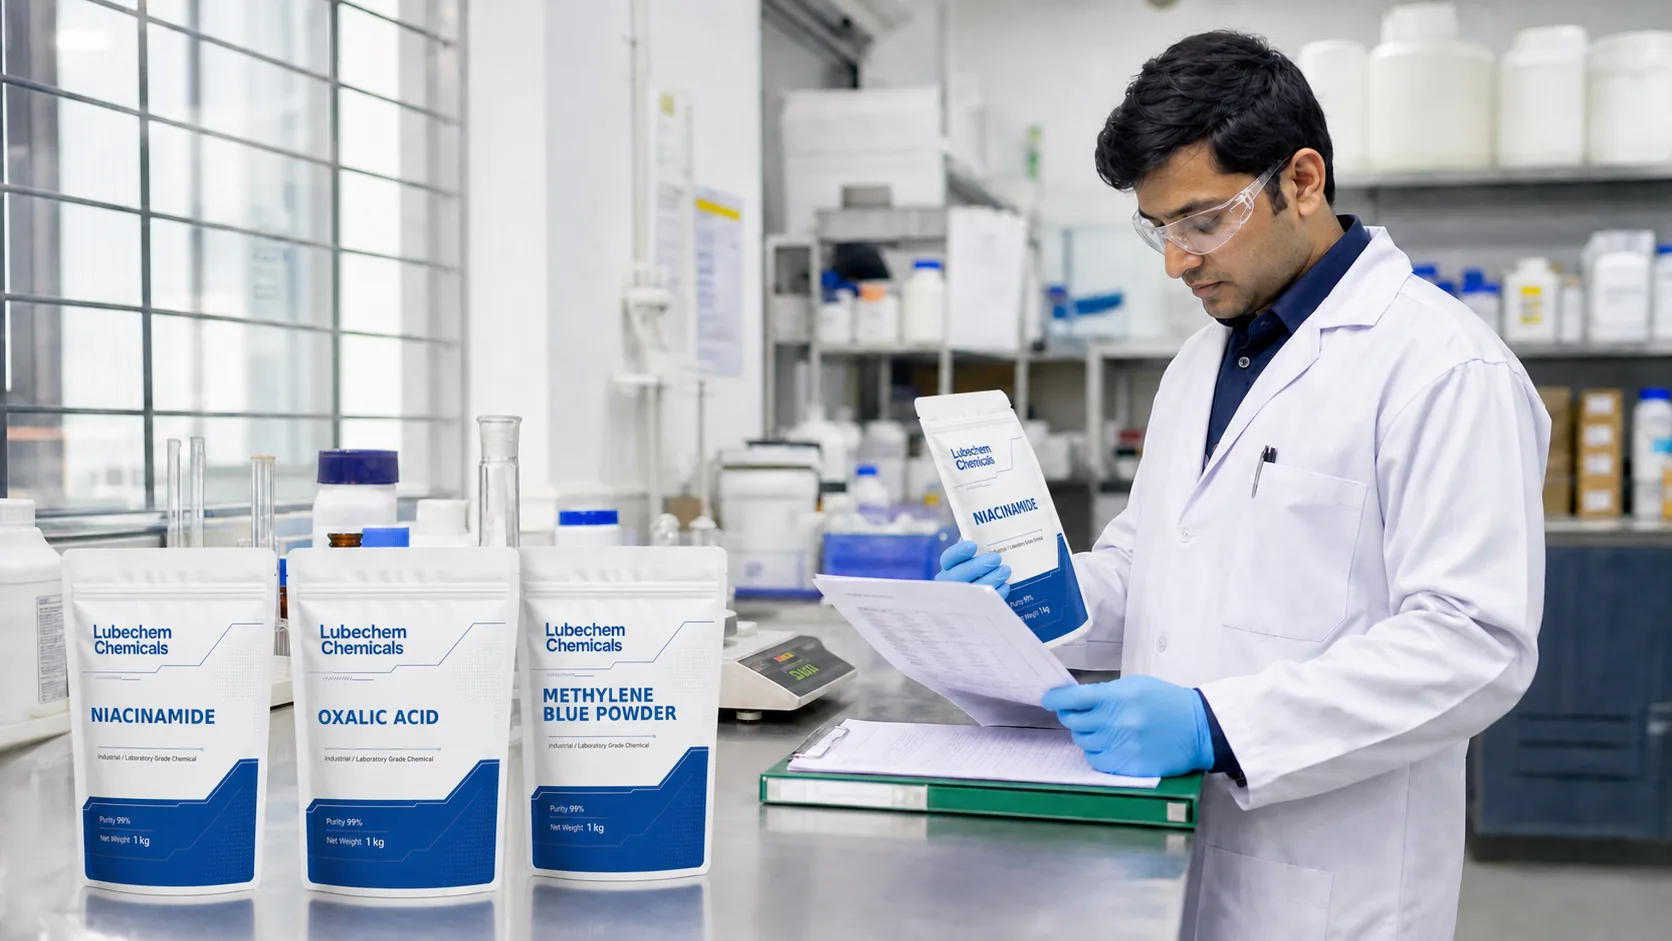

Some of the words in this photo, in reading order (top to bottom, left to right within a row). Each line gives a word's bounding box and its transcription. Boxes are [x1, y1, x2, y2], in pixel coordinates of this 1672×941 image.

[972, 498, 1039, 526] NIACINAMIDE
[93, 624, 172, 639] Lubechem
[319, 624, 407, 639] Lubechem
[545, 622, 626, 637] Lubechem
[94, 640, 169, 655] Chemicals
[321, 640, 404, 655] Chemicals
[546, 638, 623, 652] Chemicals
[543, 687, 654, 703] METHYLENE
[91, 708, 215, 725] NIACINAMIDE
[317, 709, 388, 725] OXALIC
[393, 709, 439, 725] ACID
[543, 706, 589, 721] BLUE
[596, 705, 677, 721] POWDER
[577, 742, 607, 750] Laboratory
[125, 755, 153, 763] Laboratory
[355, 755, 387, 763] Laboratory
[549, 805, 568, 814] Purity
[569, 805, 585, 813] 99%
[99, 816, 116, 825] Purity
[116, 816, 131, 825] 99%
[326, 818, 345, 827] Purity
[346, 818, 363, 826] 99%
[550, 823, 561, 831] Net
[562, 823, 584, 833] Weight
[587, 823, 592, 832] 1
[594, 823, 605, 834] kg
[133, 835, 138, 845] 1
[139, 835, 150, 847] kg
[326, 837, 339, 845] Net
[339, 837, 362, 847] Weight
[366, 837, 371, 846] 1
[373, 837, 385, 848] kg
